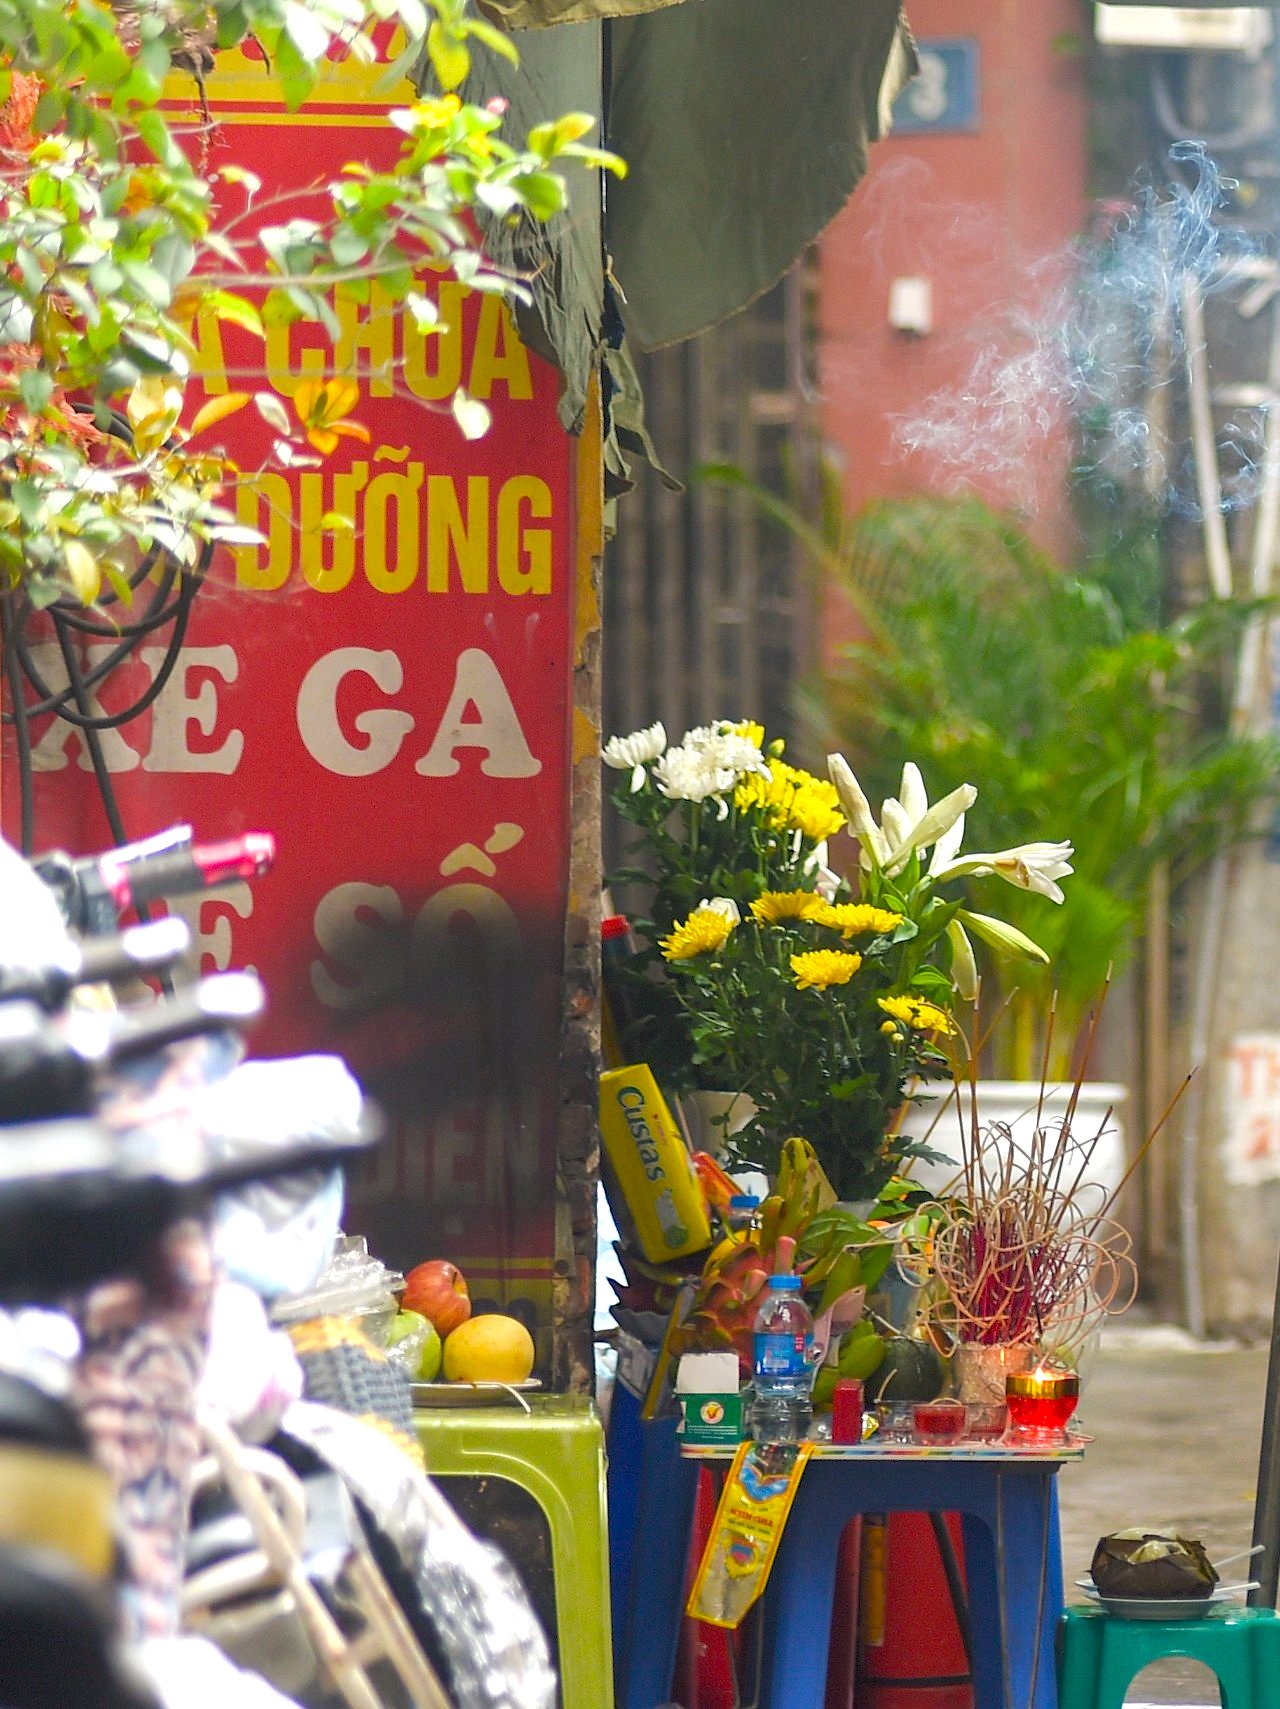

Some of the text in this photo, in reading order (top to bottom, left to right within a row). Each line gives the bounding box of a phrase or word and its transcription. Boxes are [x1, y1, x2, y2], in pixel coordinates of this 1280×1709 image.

[234, 444, 553, 596] DƯỠNG
[24, 643, 542, 778] XE GA
[616, 1086, 666, 1182] Custas
